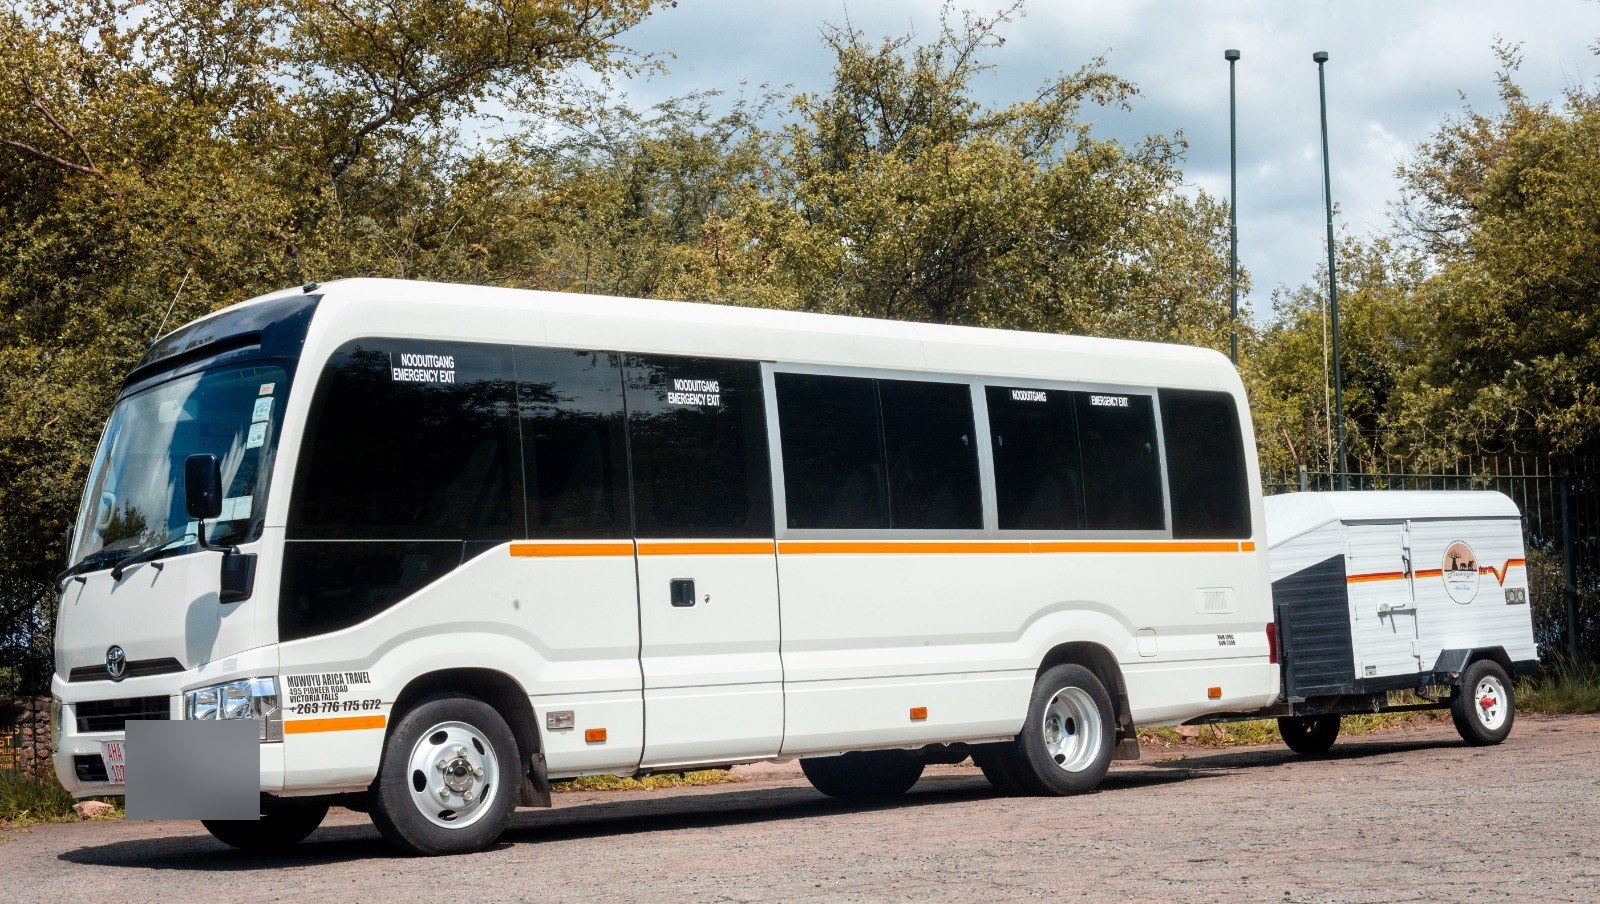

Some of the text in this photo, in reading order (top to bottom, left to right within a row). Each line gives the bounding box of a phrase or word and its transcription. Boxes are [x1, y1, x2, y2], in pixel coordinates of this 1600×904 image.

[400, 353, 455, 369] NOODUITGANG
[393, 367, 455, 383] EMERGENCY EXIT
[674, 379, 719, 392] NOODUITGANG
[667, 392, 720, 406] EMERGENCY EXIT
[287, 671, 371, 688] MUWUYU ARICA TRAVEL
[303, 685, 330, 695] PIONEER
[330, 685, 348, 693] ROAD
[289, 693, 339, 703] VICTORIA FALLS
[290, 699, 381, 714] +263 776 175 672
[107, 742, 123, 760] AHA
